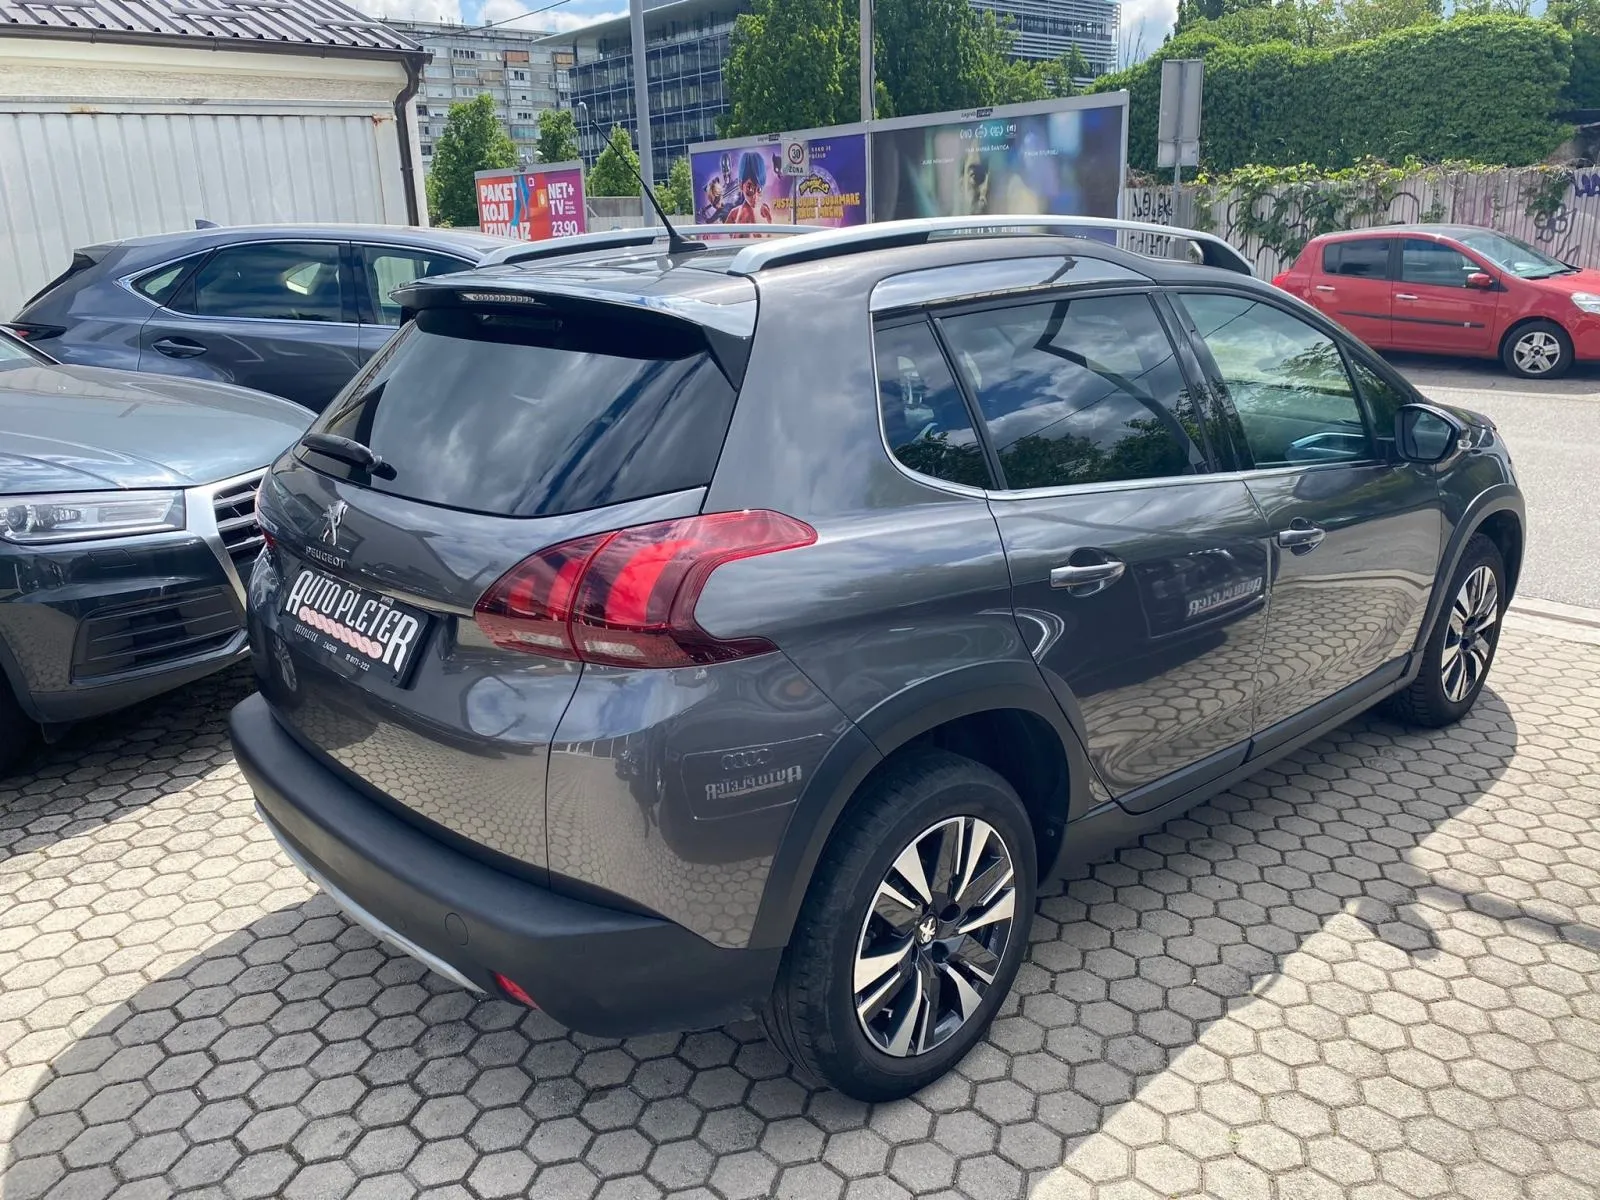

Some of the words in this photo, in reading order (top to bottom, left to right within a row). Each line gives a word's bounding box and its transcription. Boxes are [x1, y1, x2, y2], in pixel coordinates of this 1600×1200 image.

[791, 148, 801, 160] 30
[788, 166, 804, 174] ZONA
[480, 182, 518, 202] PAKET
[547, 182, 575, 200] NET+
[482, 203, 510, 222] KOJI
[549, 199, 565, 216] TV
[305, 545, 346, 569] PEUGEOT
[285, 570, 342, 615] AUTO
[333, 589, 419, 673] PLETER
